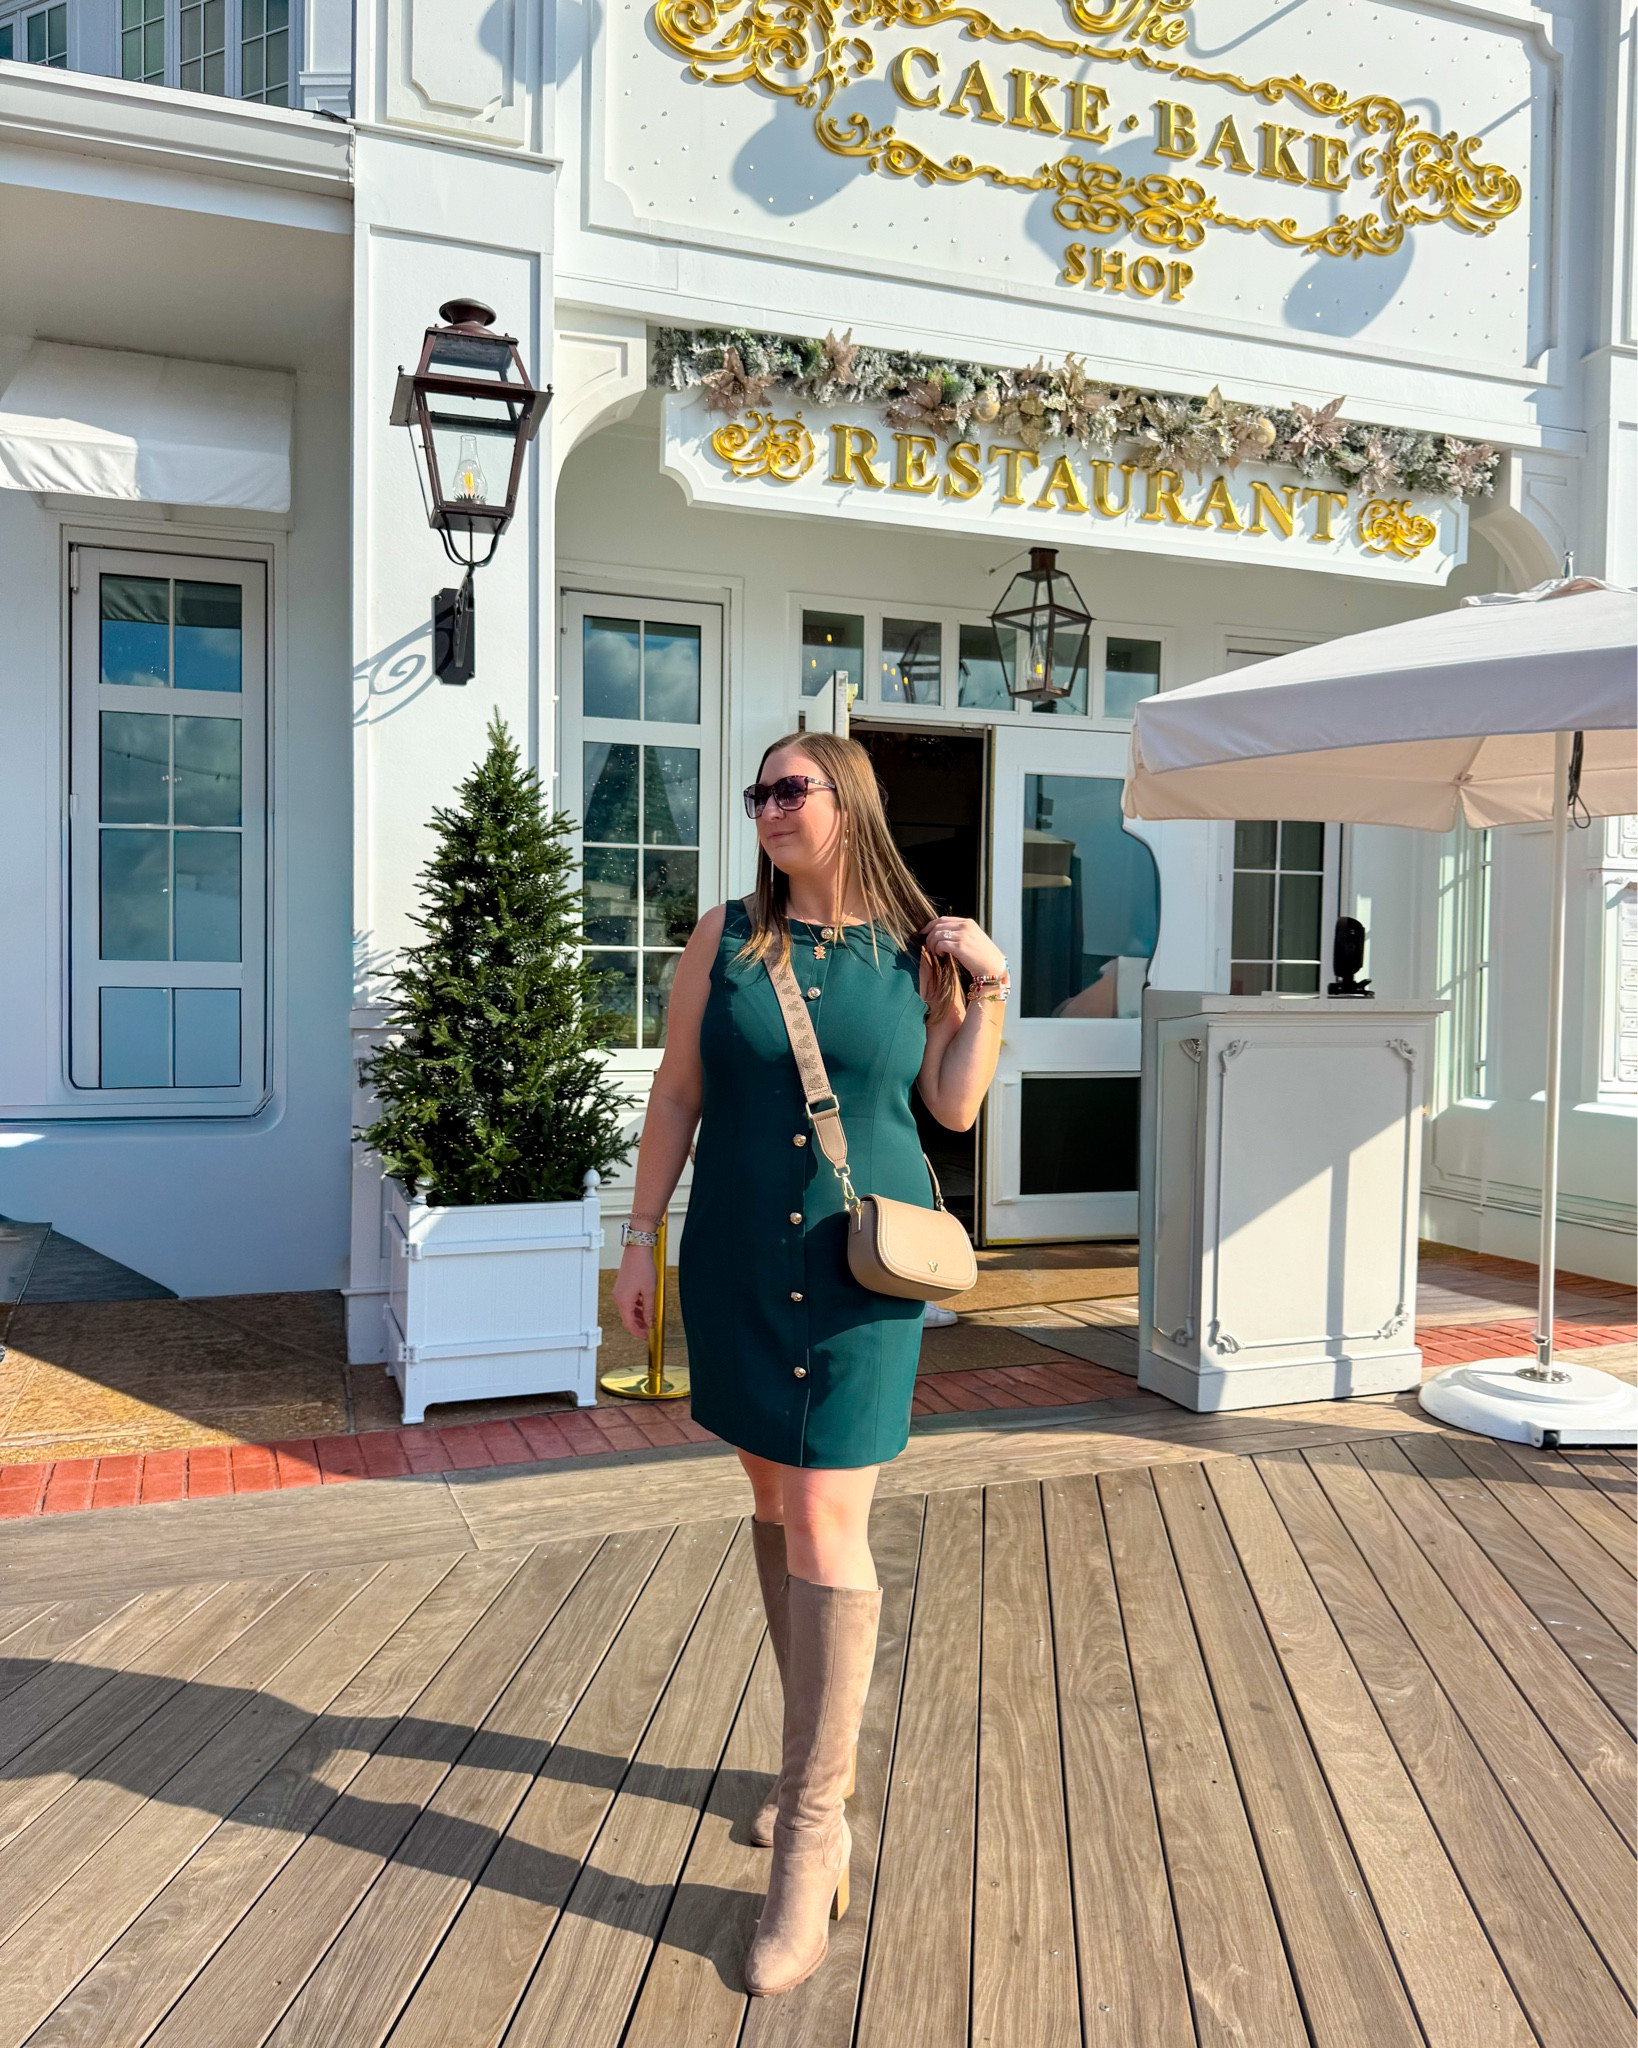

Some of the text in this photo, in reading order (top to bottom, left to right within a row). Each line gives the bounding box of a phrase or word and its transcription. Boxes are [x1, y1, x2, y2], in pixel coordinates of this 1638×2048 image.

[891, 46, 1352, 192] CAKE BAKE
[1063, 242, 1194, 302] SHOP
[829, 423, 1348, 541] RESTAURANT
